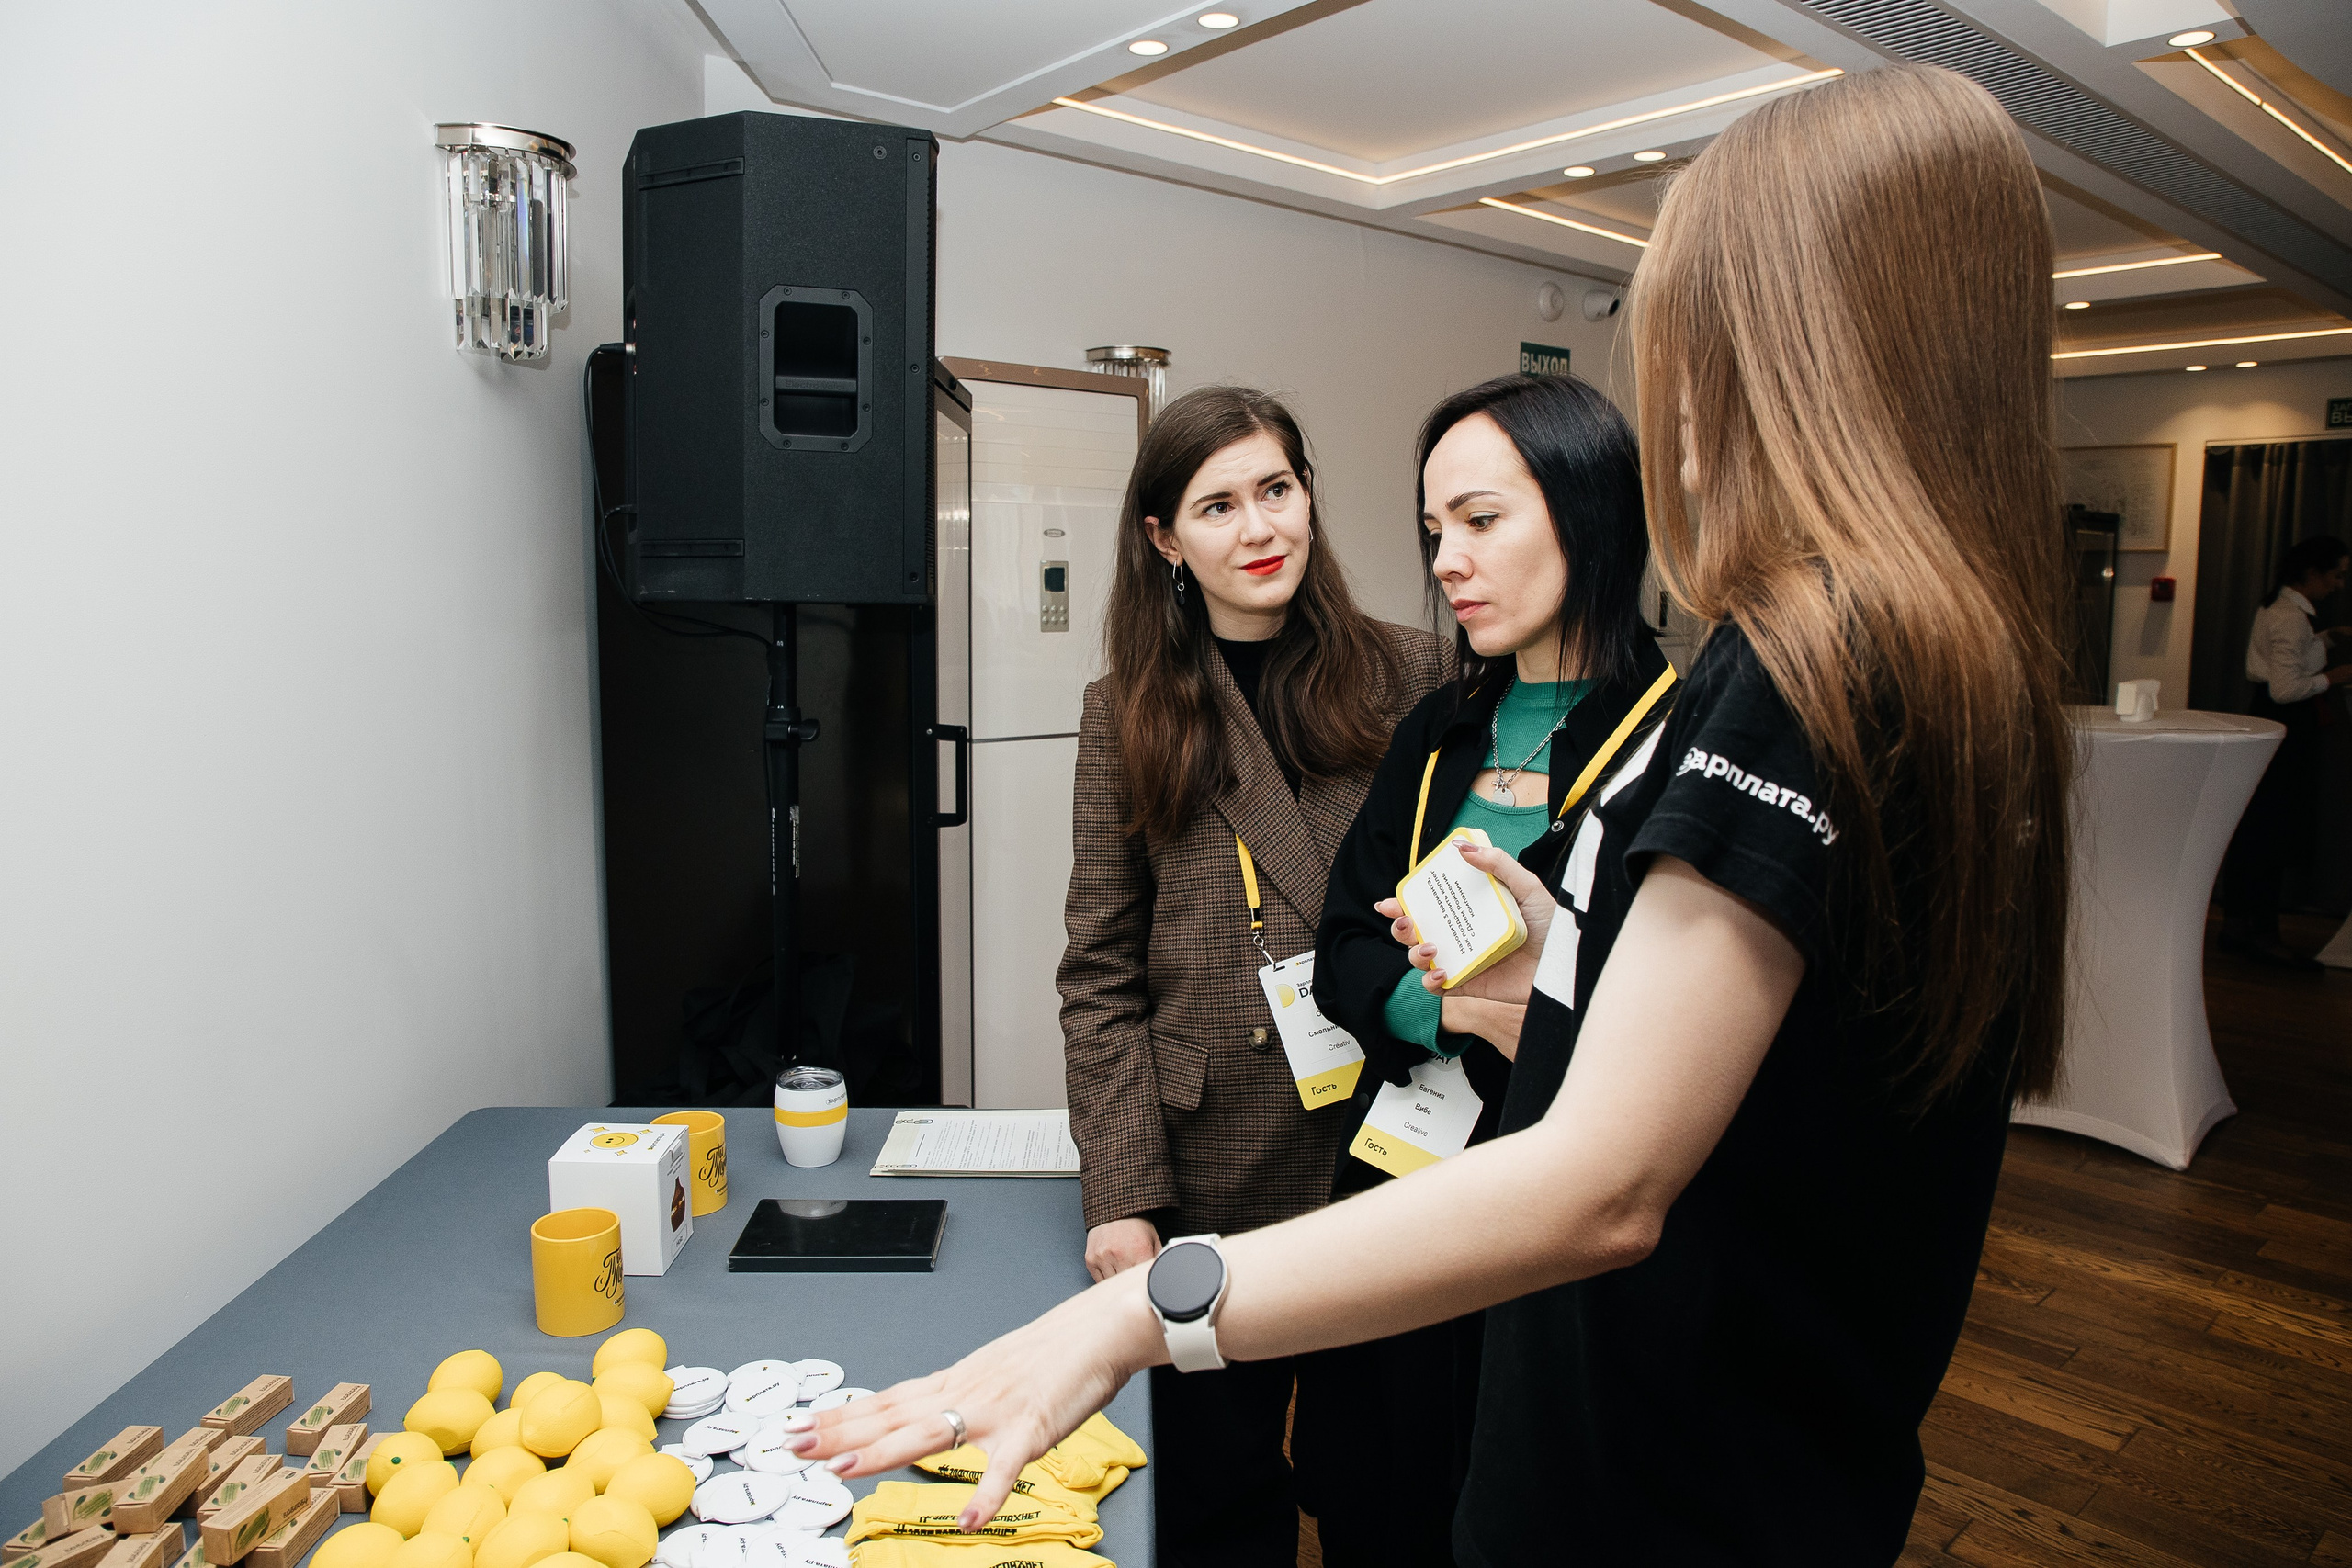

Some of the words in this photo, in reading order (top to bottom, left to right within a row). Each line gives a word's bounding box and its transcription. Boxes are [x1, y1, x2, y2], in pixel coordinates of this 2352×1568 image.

[1521, 352, 1570, 376] ВЫХОД
[1430, 870, 1445, 895] коллег
[1441, 872, 1462, 910] Рождения
[1427, 876, 1446, 914] варианта,
[1454, 880, 1475, 918] компании
[1444, 895, 1467, 938] поздравить
[1447, 919, 1465, 955] Назовите
[1464, 939, 1474, 952] как
[1311, 1083, 1338, 1096] Гость
[1419, 1083, 1445, 1100] Евгения
[1415, 1103, 1432, 1115] Вибе
[1403, 1122, 1429, 1137] Creative
[1363, 1138, 1388, 1156] Гость
